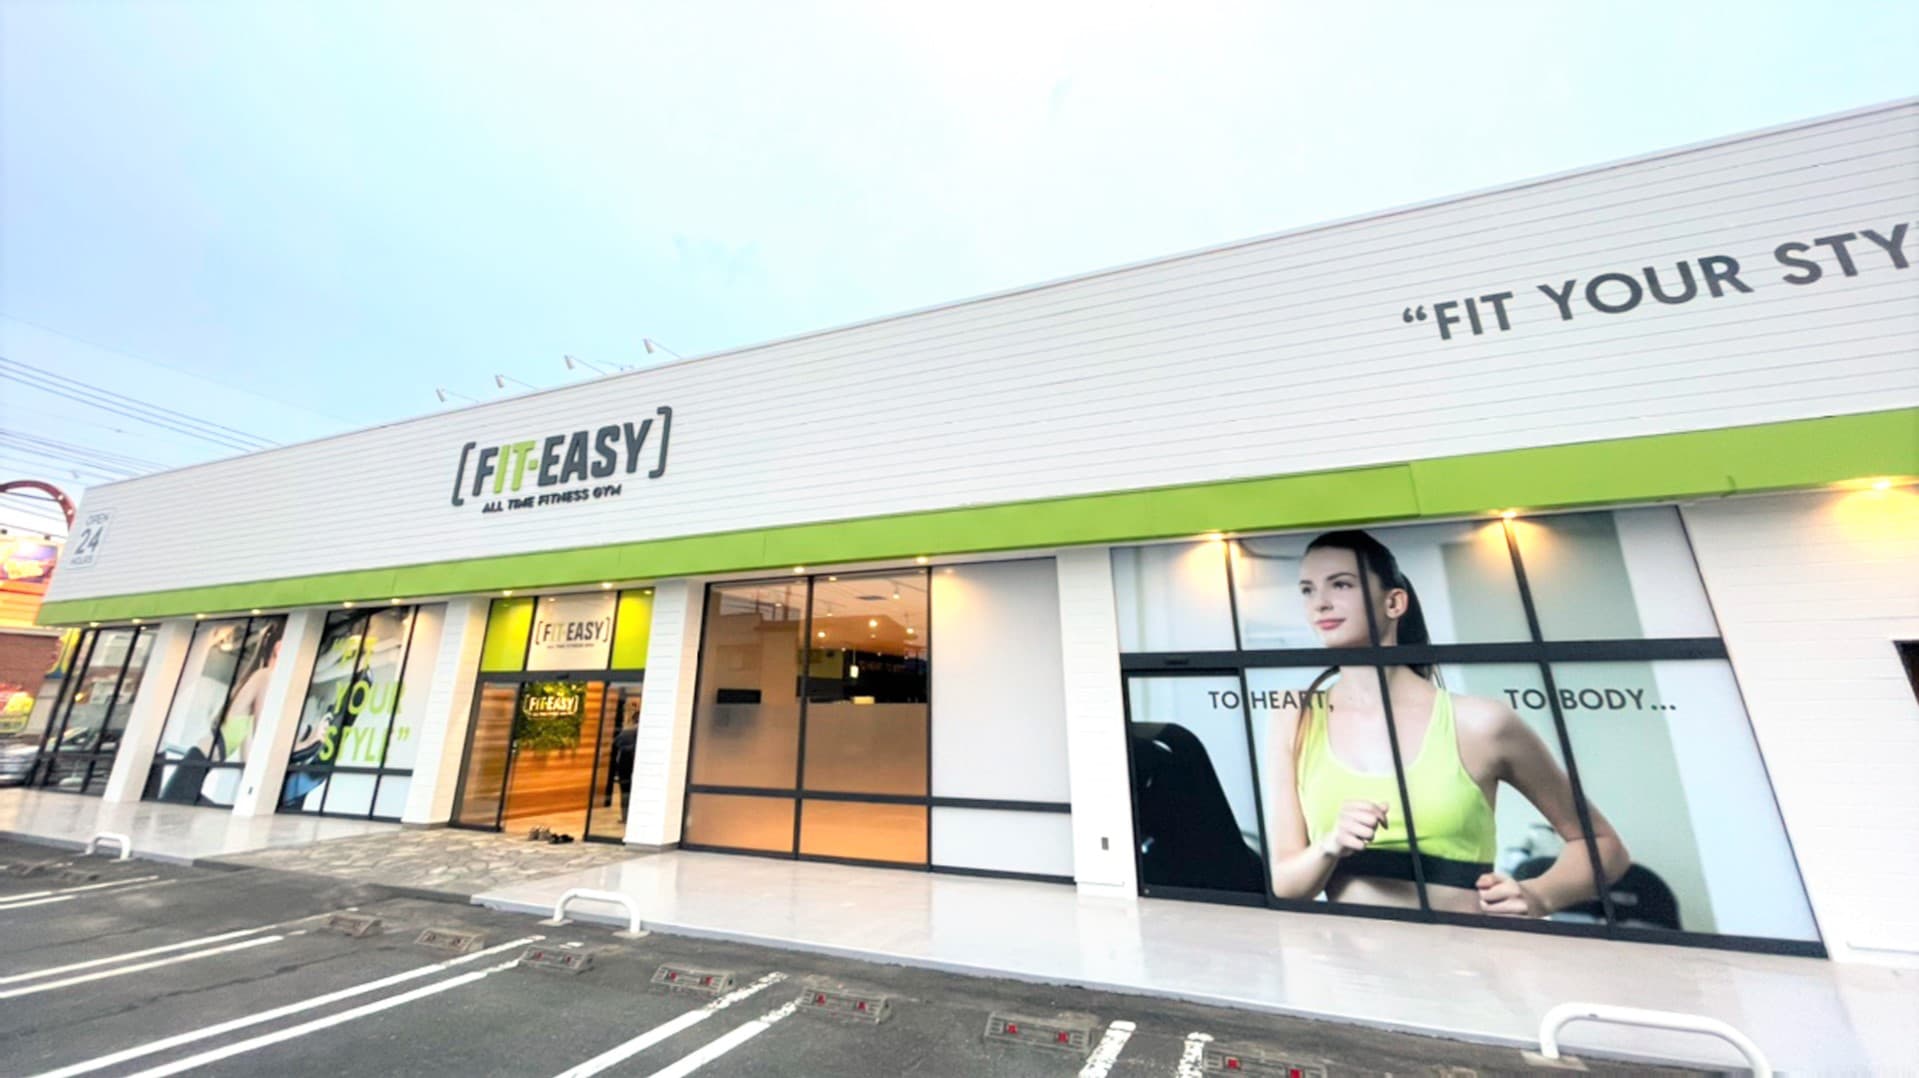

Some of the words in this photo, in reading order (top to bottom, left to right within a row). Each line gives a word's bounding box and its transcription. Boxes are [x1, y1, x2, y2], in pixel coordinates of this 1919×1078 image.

[1537, 255, 1754, 320] YOUR
[1774, 221, 1919, 285] STY
[481, 501, 504, 513] ALL
[508, 496, 535, 510] TIME
[538, 489, 589, 506] FITNESS
[593, 484, 622, 499] GYM
[74, 526, 104, 555] 24
[1208, 690, 1241, 709] TO
[1504, 689, 1546, 710] TO
